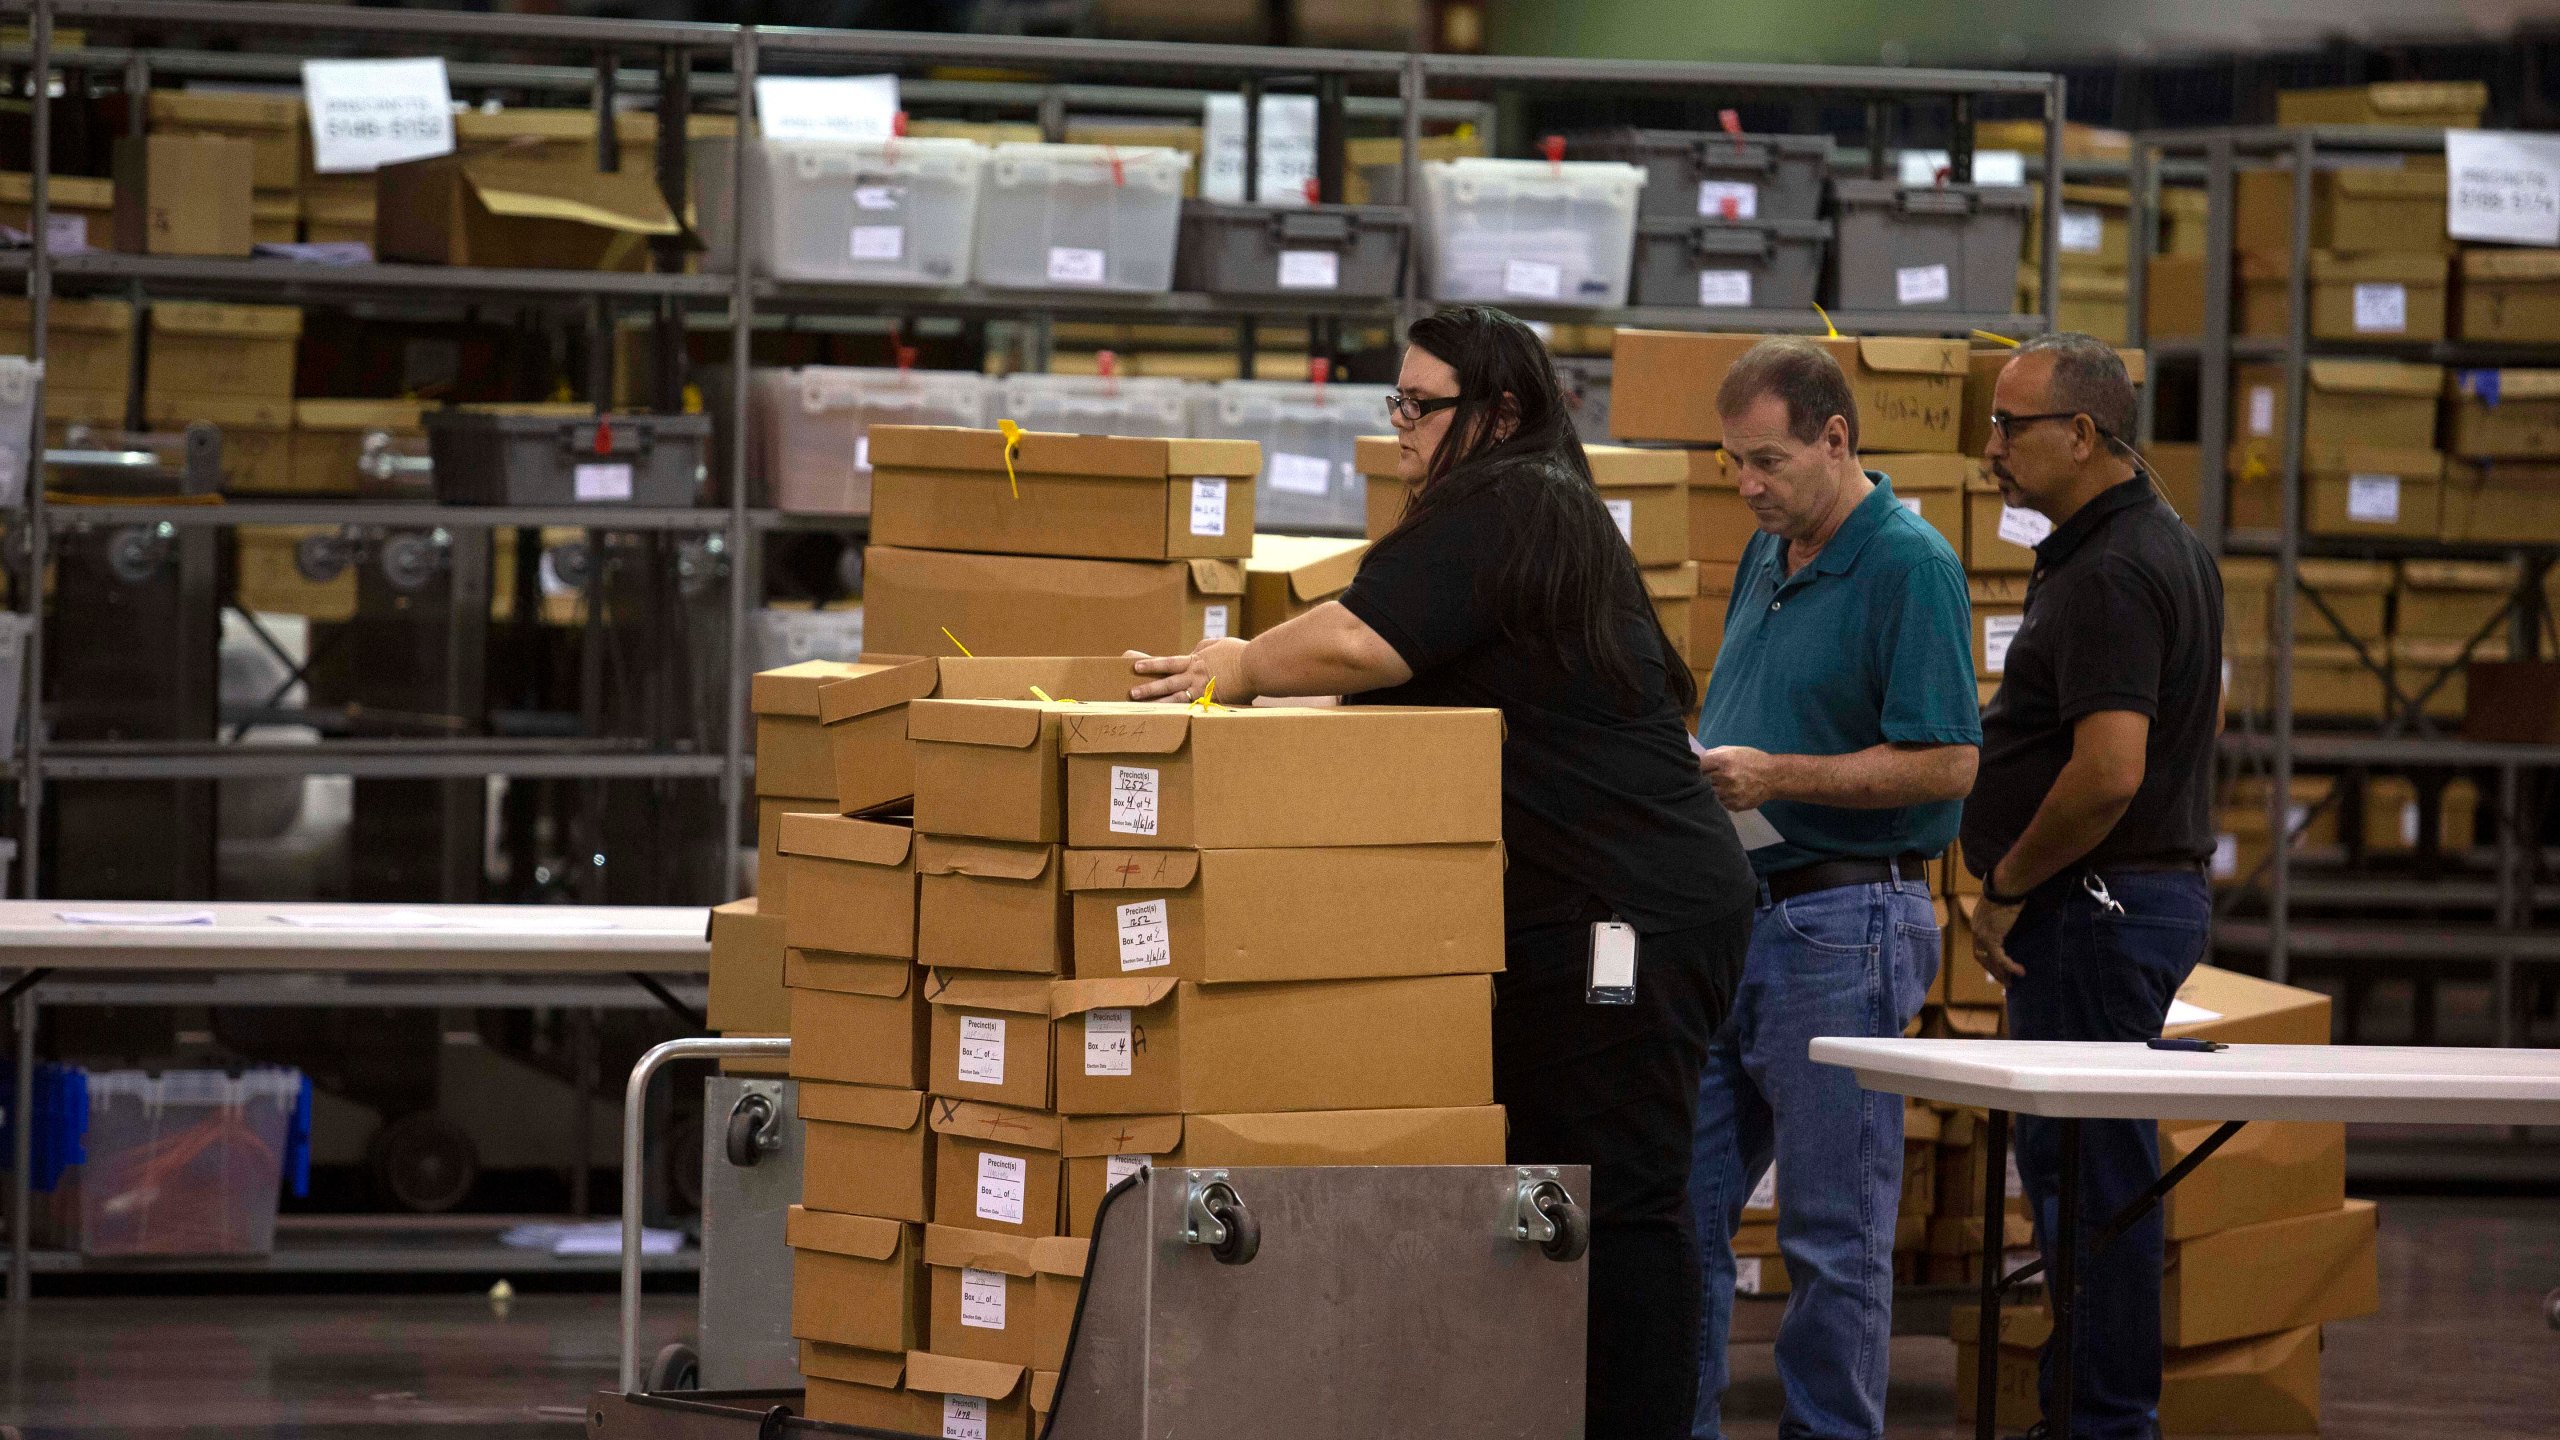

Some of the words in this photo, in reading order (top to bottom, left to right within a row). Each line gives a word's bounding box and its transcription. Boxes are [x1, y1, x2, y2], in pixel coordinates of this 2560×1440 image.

[1120, 770, 1150, 780] Precinct(s)
[1113, 798, 1124, 806] Box
[1136, 800, 1143, 808] of
[1144, 797, 1151, 808] 4
[1125, 905, 1157, 916] Precinct(s)
[1093, 1013, 1122, 1022] Precinct(s)
[968, 1020, 997, 1031] Precinct(s)
[1088, 1042, 1098, 1050] Box
[962, 1048, 972, 1056] Box
[984, 1050, 990, 1058] of
[987, 1158, 1017, 1171] Precinct(s)
[981, 1186, 991, 1195] Box
[1003, 1190, 1010, 1198] of
[964, 1292, 974, 1301] Box
[986, 1295, 991, 1303] of
[952, 1398, 978, 1410] Precinct(s)
[946, 1427, 956, 1435] Box
